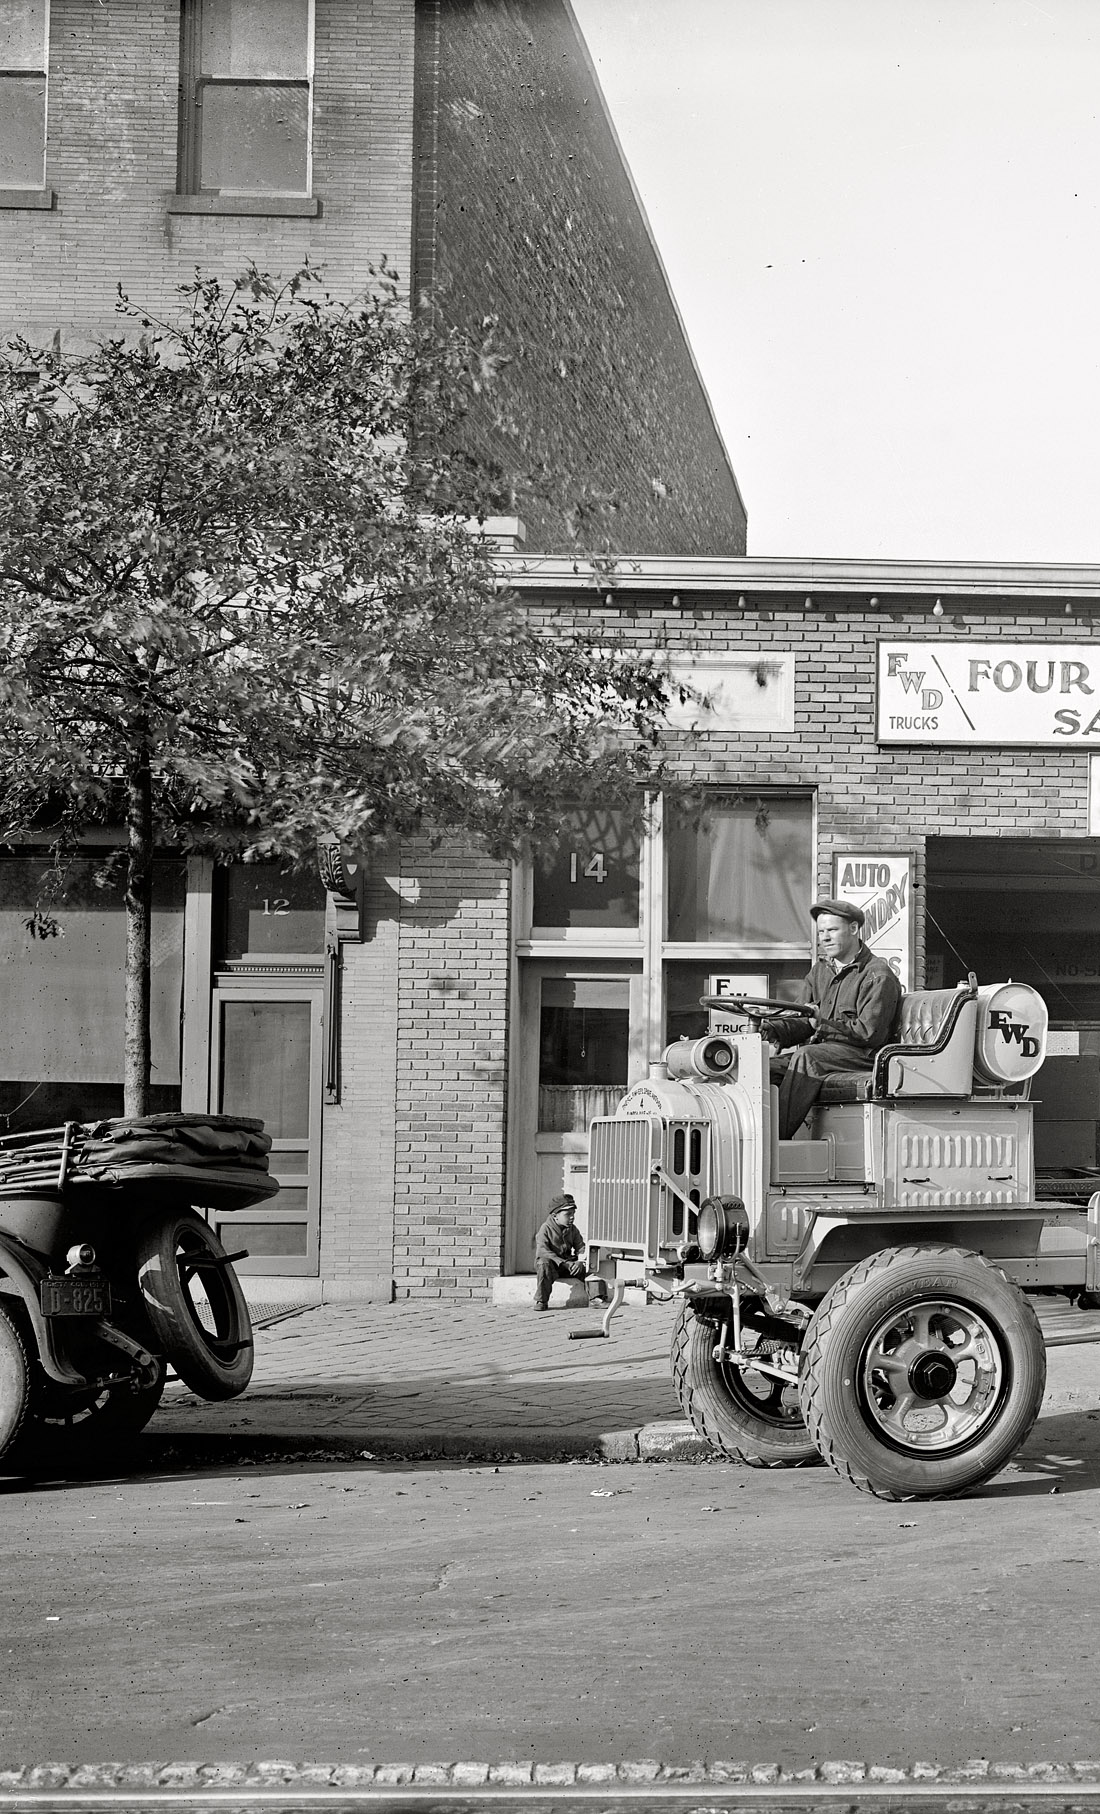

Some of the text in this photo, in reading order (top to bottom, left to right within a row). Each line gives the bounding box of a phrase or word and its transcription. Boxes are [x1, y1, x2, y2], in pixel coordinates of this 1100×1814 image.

[967, 659, 1095, 695] FOUR
[889, 716, 939, 730] TRUCKS
[570, 852, 609, 883] 14
[840, 863, 891, 888] AUTO
[261, 898, 291, 916] 12
[50, 1288, 103, 1313] D-825
